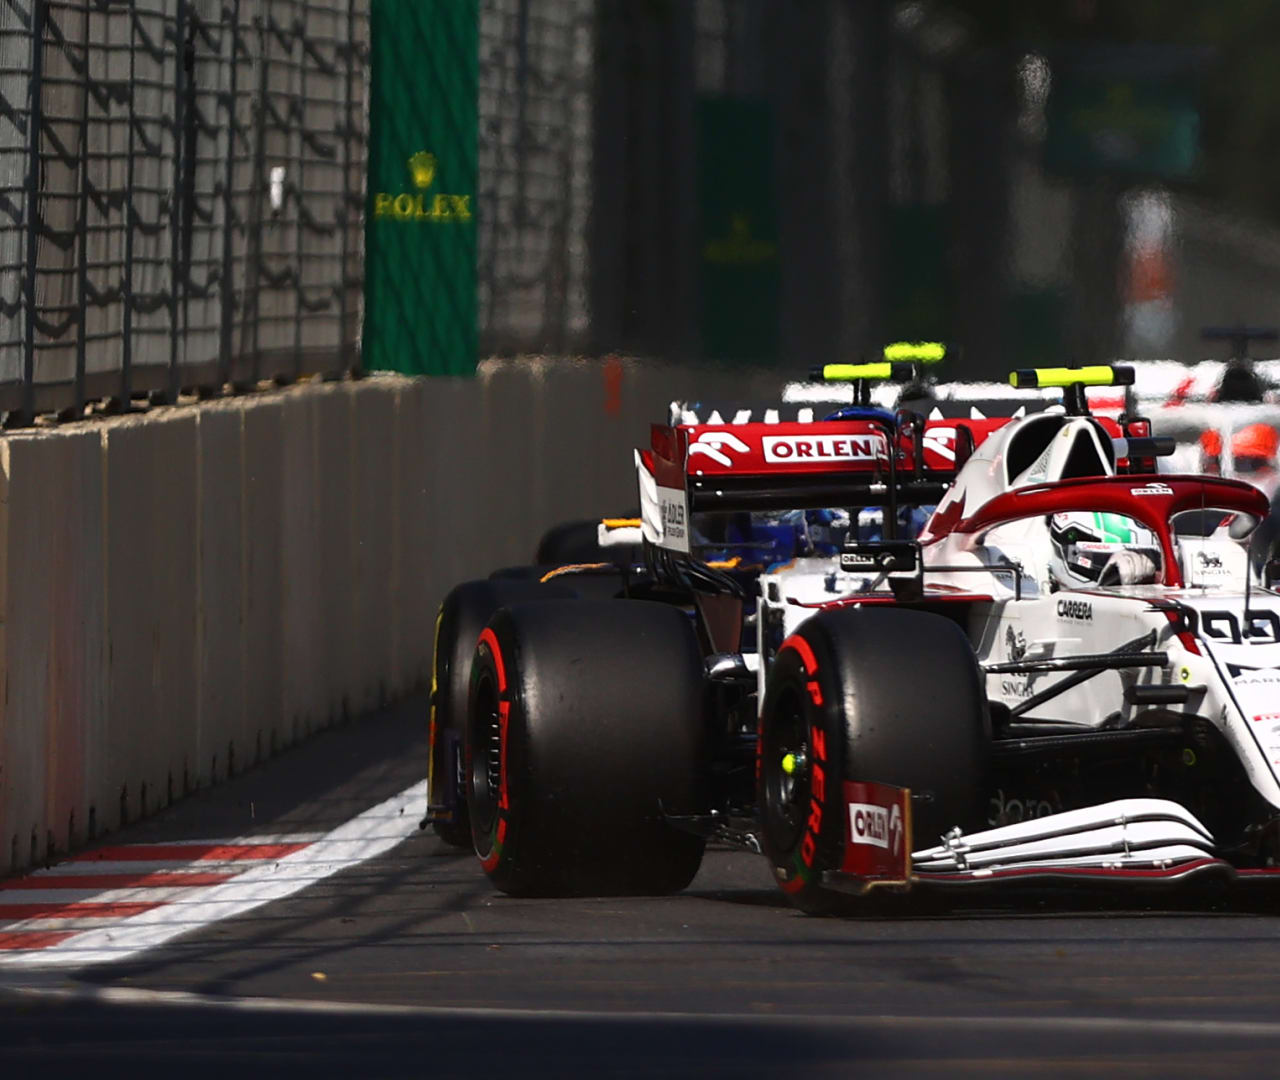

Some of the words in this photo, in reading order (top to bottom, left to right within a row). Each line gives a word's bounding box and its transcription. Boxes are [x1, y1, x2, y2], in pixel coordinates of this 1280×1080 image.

[374, 192, 471, 217] ROLEX
[771, 438, 871, 459] ORLEN
[842, 554, 874, 564] ORLEN
[1057, 600, 1093, 620] CARRERA
[855, 810, 888, 841] ORLEN
